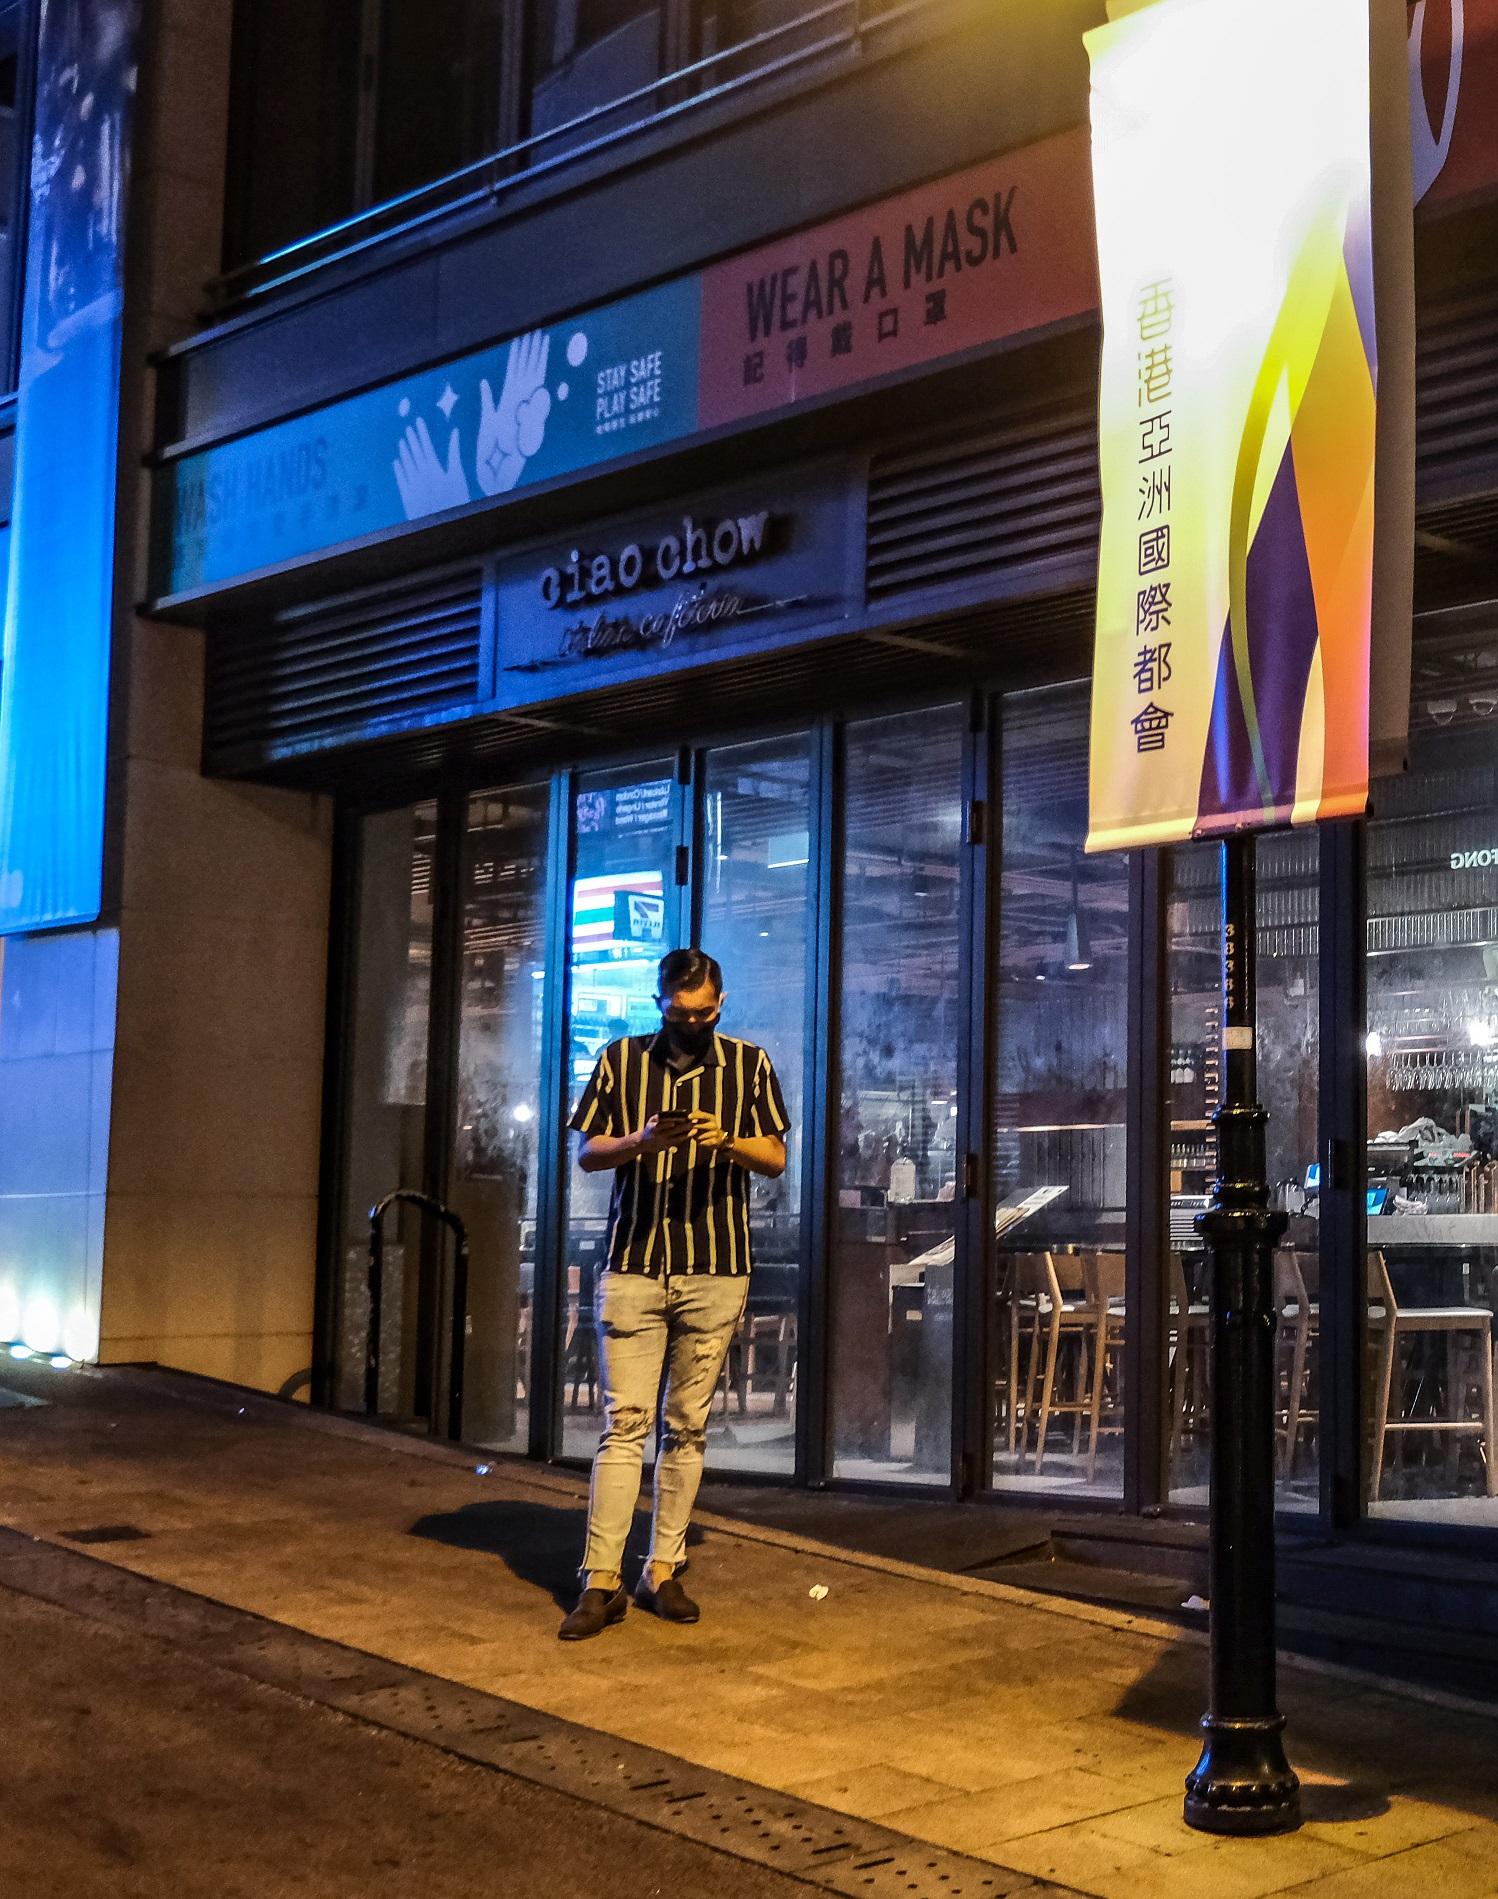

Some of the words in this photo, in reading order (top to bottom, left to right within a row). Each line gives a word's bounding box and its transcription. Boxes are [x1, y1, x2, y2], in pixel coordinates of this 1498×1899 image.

[746, 249, 849, 342] WEAR
[863, 235, 888, 304] A
[903, 185, 1018, 290] MASK
[596, 390, 626, 421] PLAY
[629, 378, 662, 410] SAFE
[597, 365, 626, 394] STAY
[629, 351, 662, 384] SAFE
[541, 544, 643, 609] ciao
[656, 511, 769, 580] chow
[1130, 277, 1175, 753] 香港亞洲國際都會
